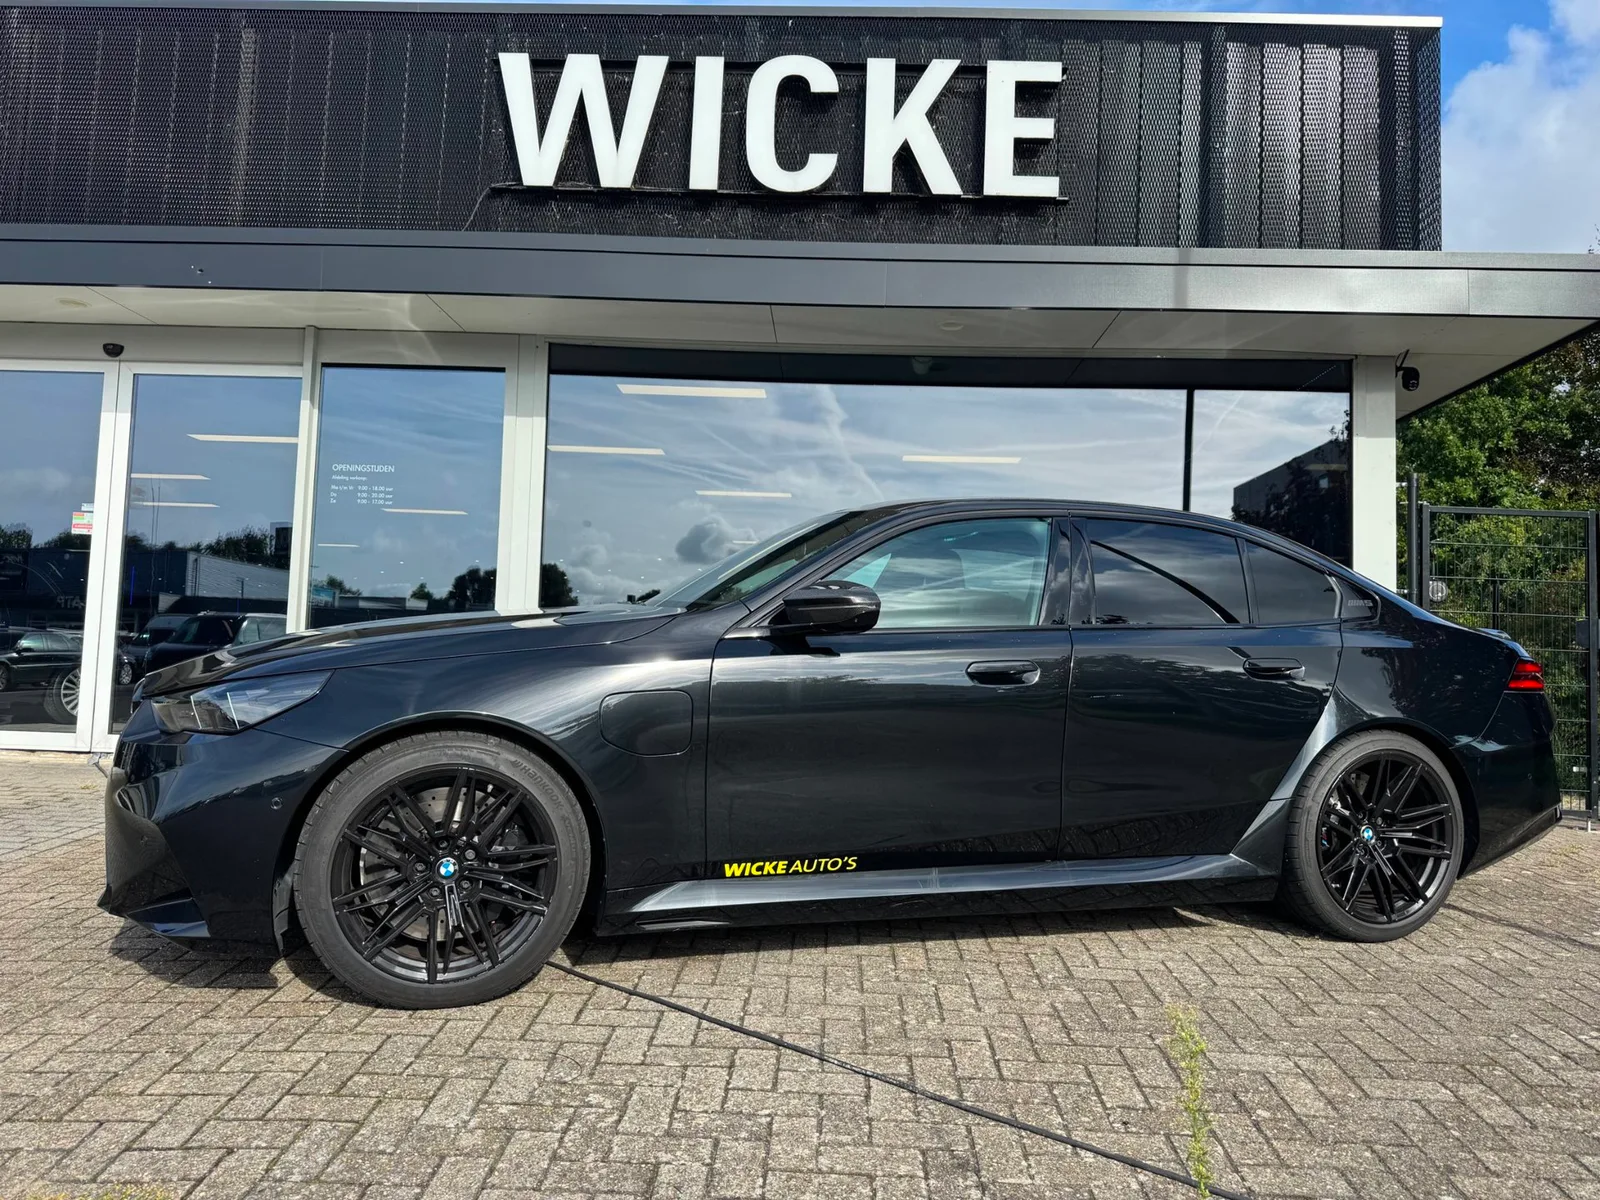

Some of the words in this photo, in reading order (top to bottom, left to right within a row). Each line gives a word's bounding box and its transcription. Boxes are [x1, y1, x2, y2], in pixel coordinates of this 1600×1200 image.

[498, 52, 1063, 198] WICKE
[724, 861, 788, 878] WICKE
[788, 856, 858, 874] AUTO'S
